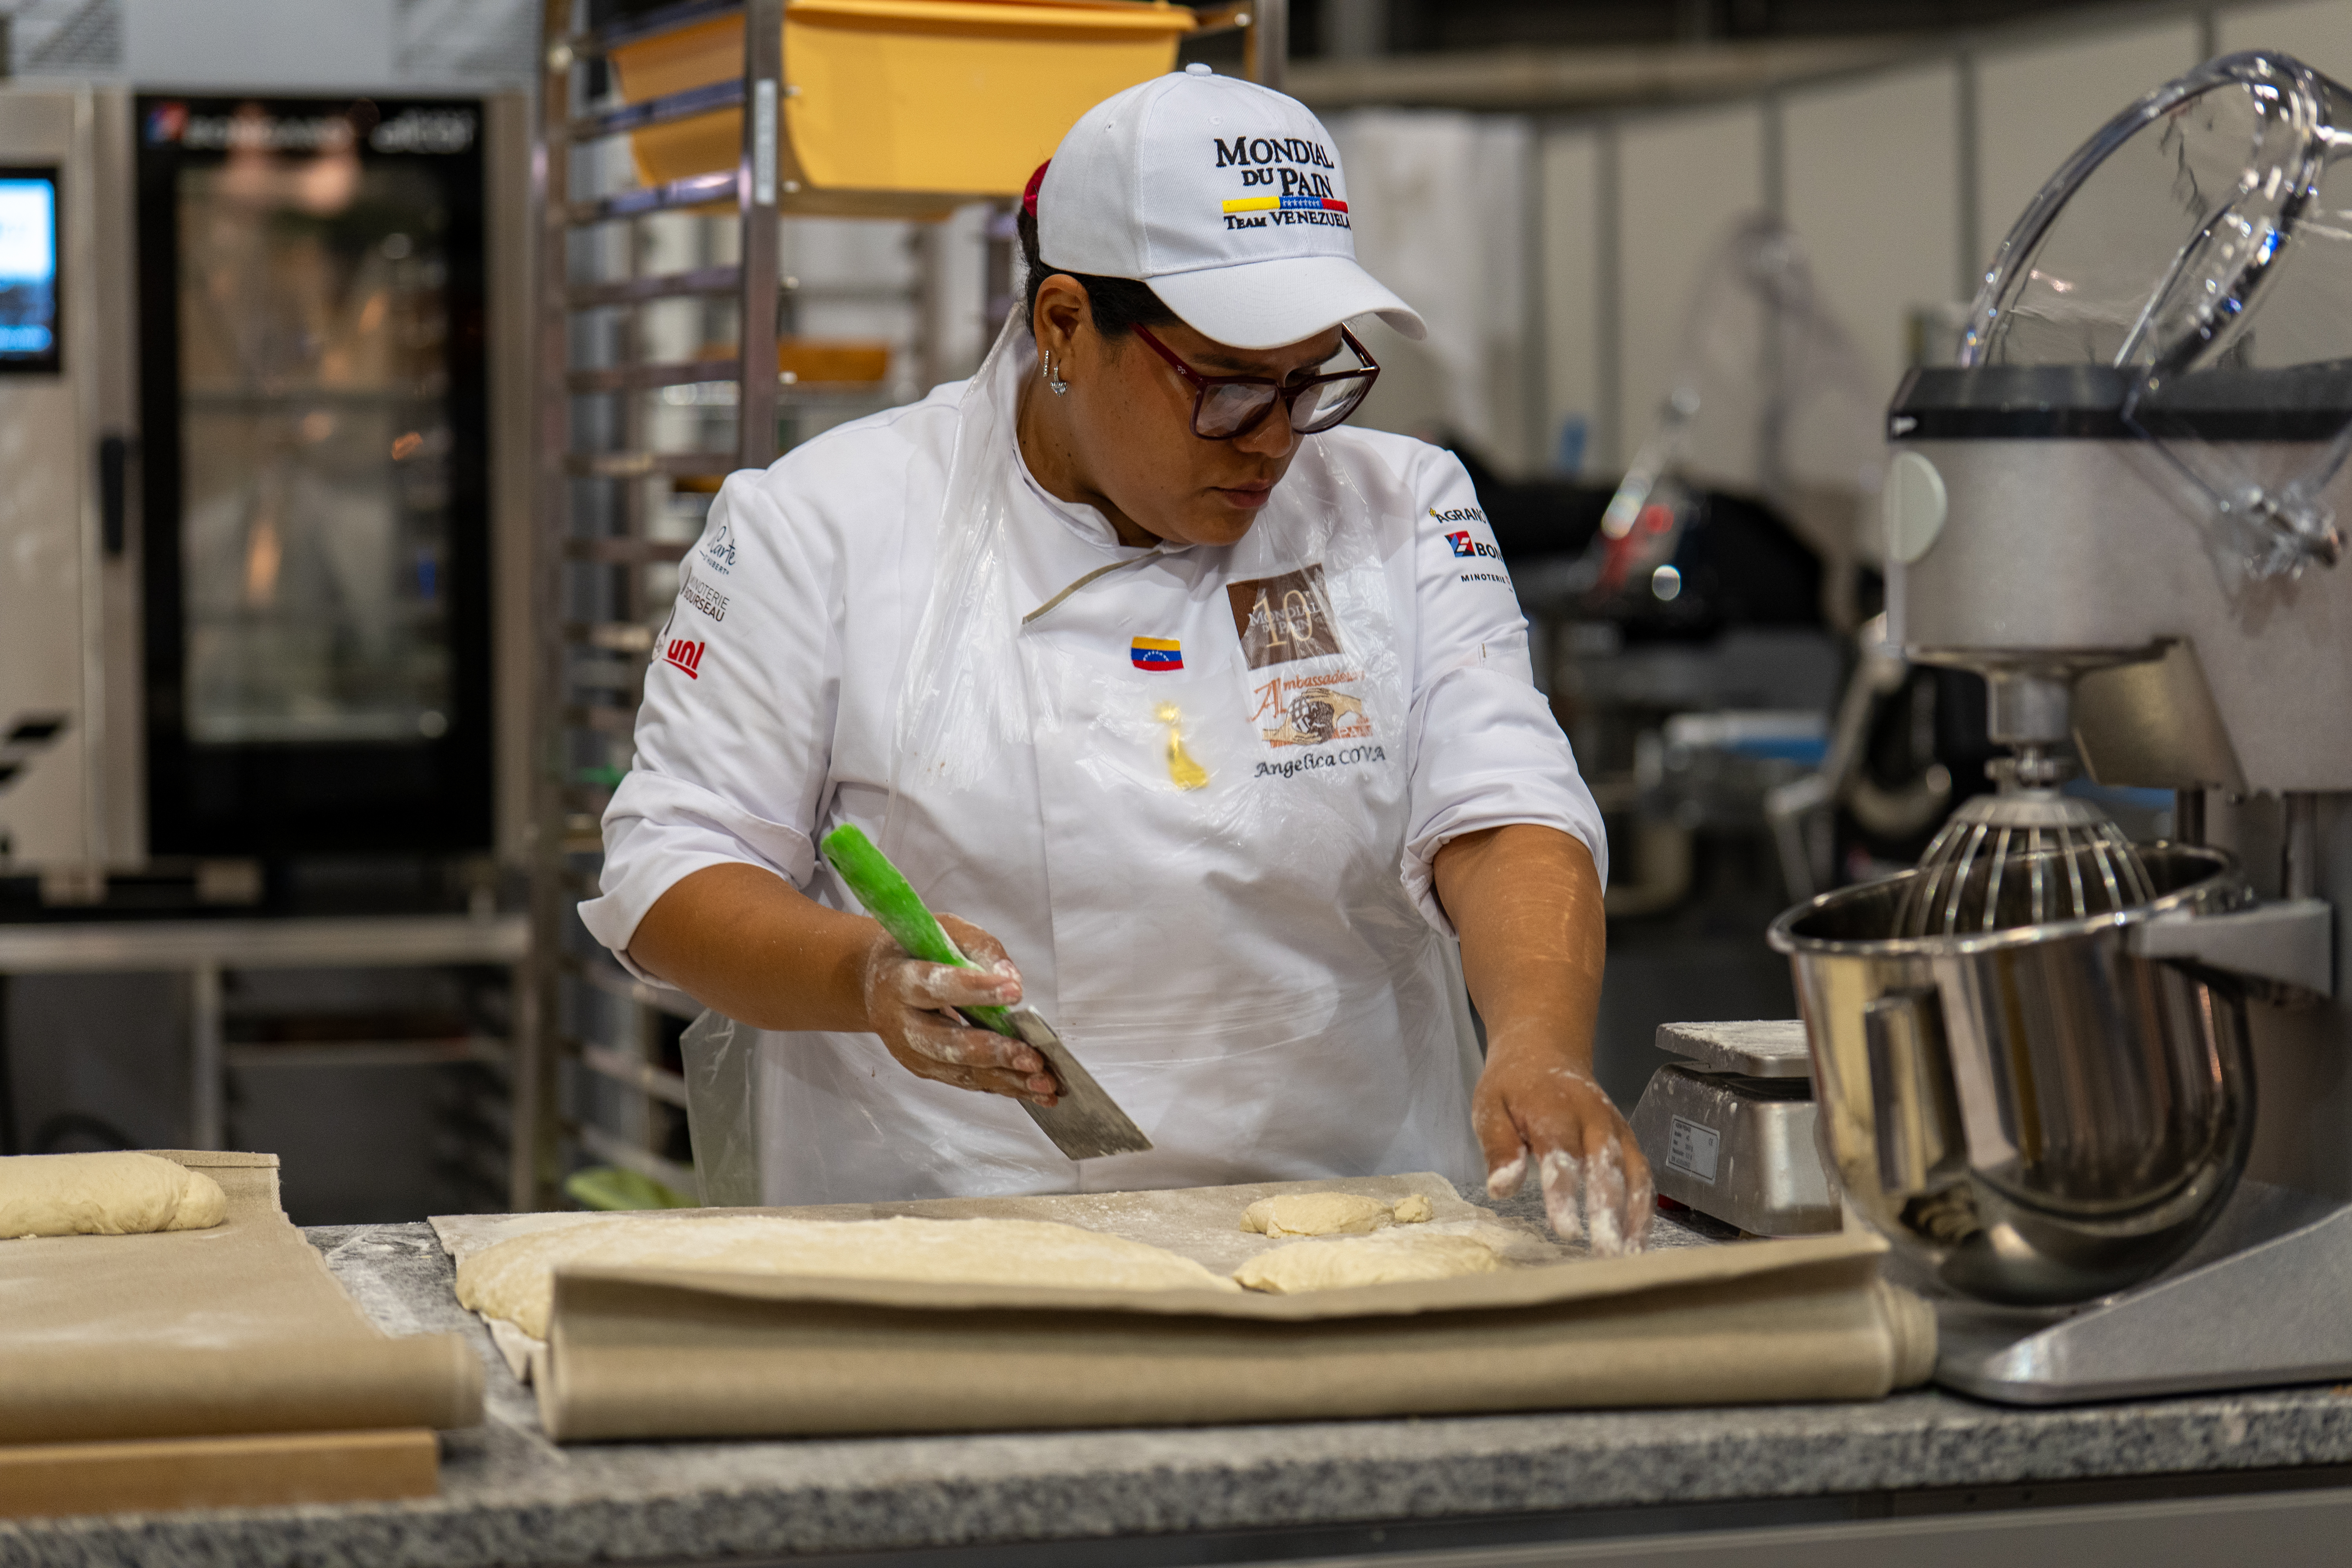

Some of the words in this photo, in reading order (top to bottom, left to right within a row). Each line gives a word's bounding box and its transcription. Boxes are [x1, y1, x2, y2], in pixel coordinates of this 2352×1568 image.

[1214, 136, 1335, 169] MONDIAL
[1241, 167, 1274, 186] DU
[1278, 168, 1334, 199] PAIN
[1269, 211, 1352, 231] VENEZUELA
[1436, 507, 1490, 523] AGRANO
[690, 574, 730, 611] MINOTERIE
[1461, 573, 1506, 584] MINOTERIE
[684, 586, 724, 622] BOURSEAU
[1248, 602, 1321, 627] MONDIAL
[1253, 589, 1313, 648] 10
[1254, 753, 1336, 779] Angelica
[1339, 745, 1387, 765] COVA
